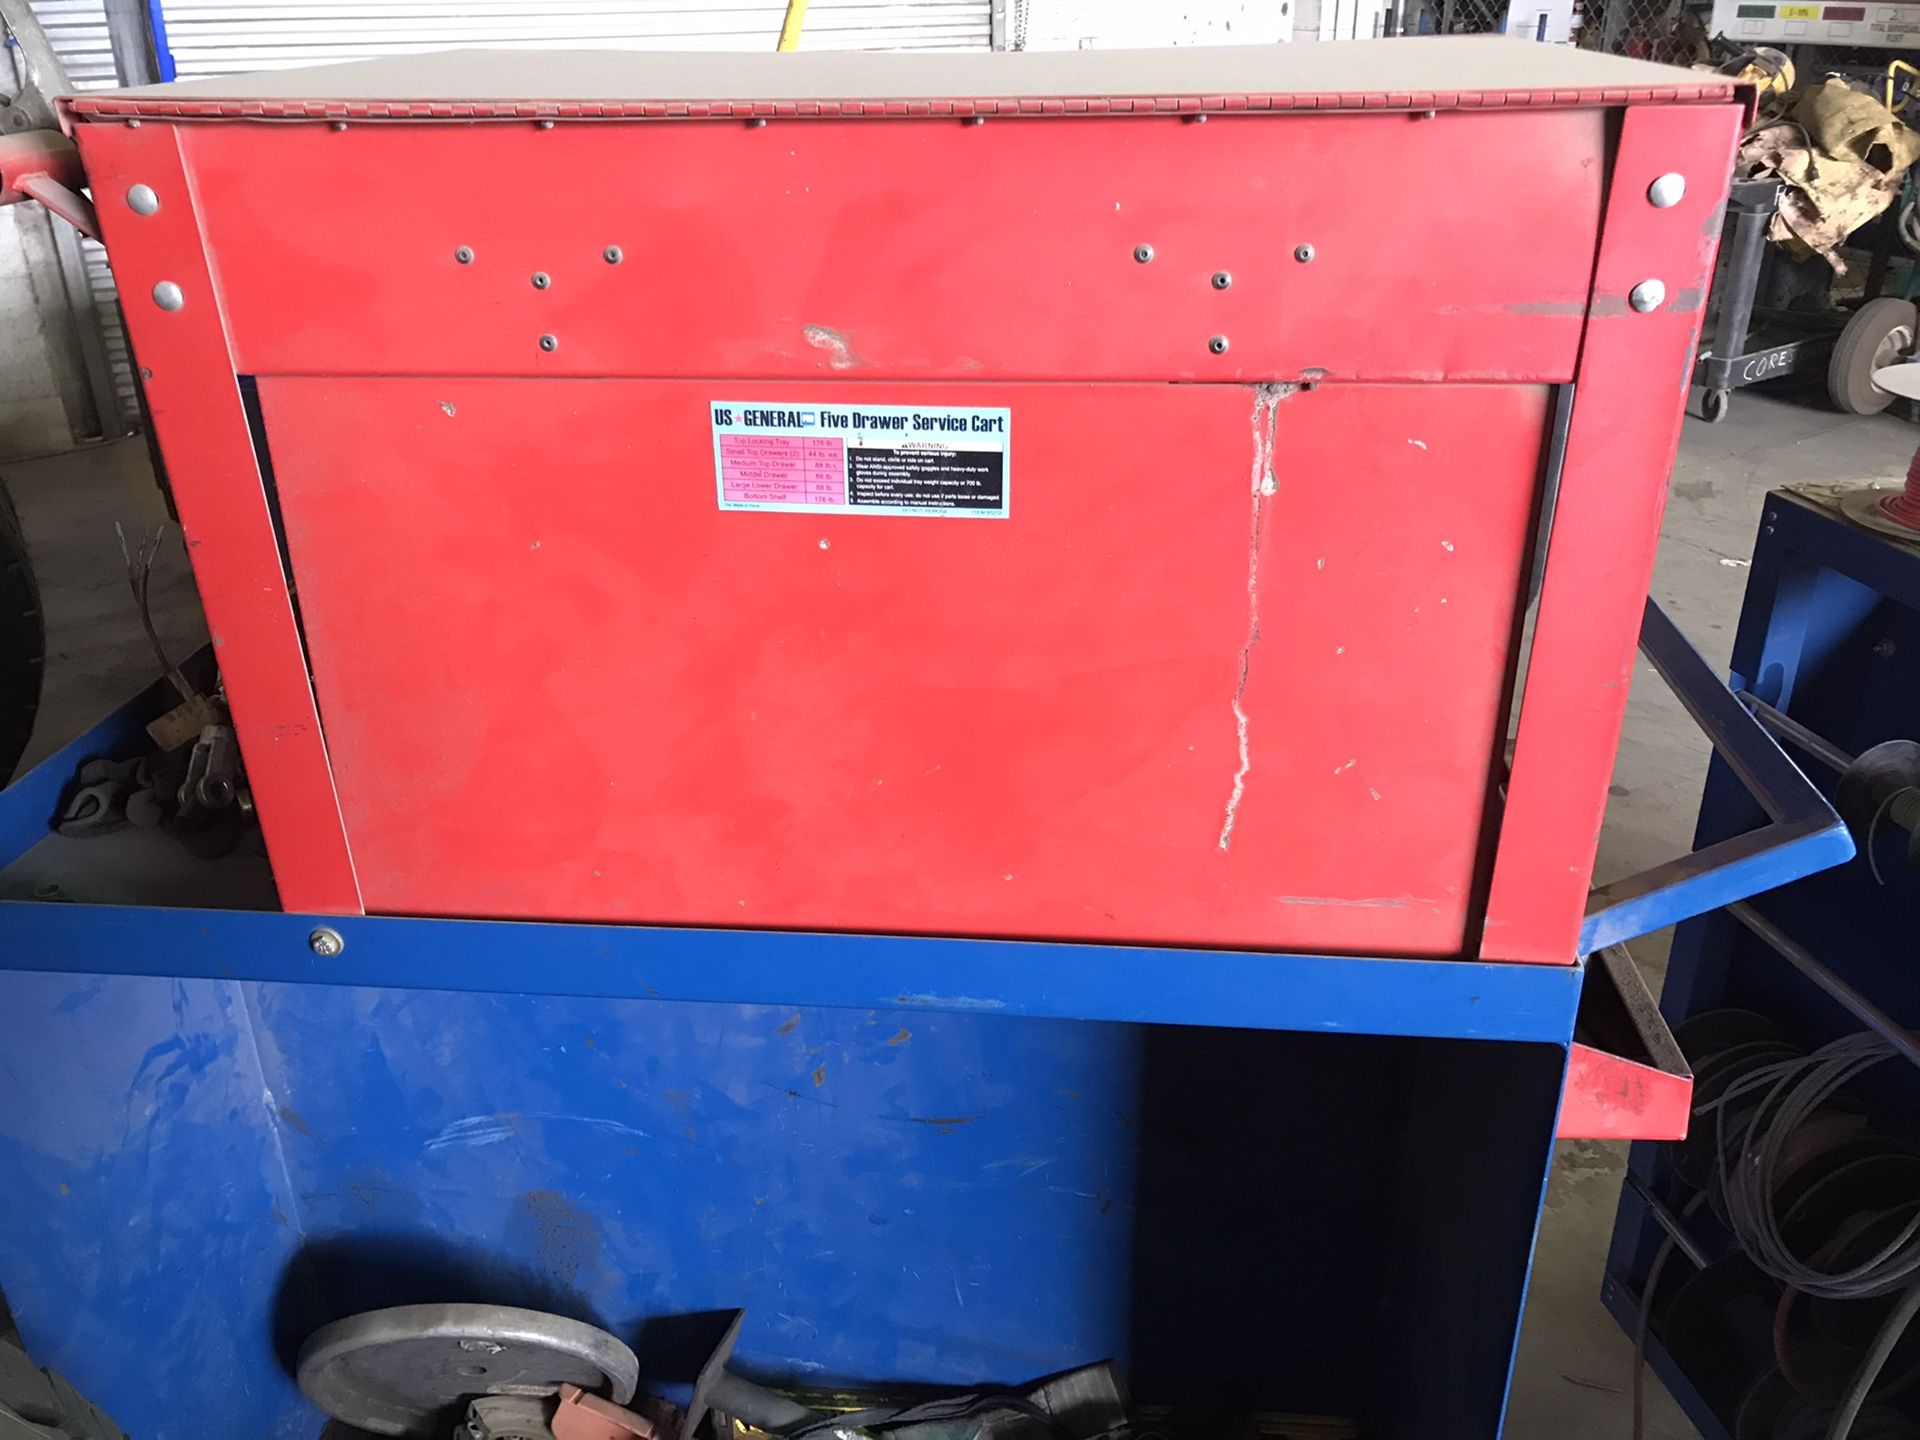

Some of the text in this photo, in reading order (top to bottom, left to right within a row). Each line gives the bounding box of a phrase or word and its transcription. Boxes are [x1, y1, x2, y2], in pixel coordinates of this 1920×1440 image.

[714, 409, 804, 428] US GENERAL
[820, 411, 1004, 432] Five Drawer Service Cart
